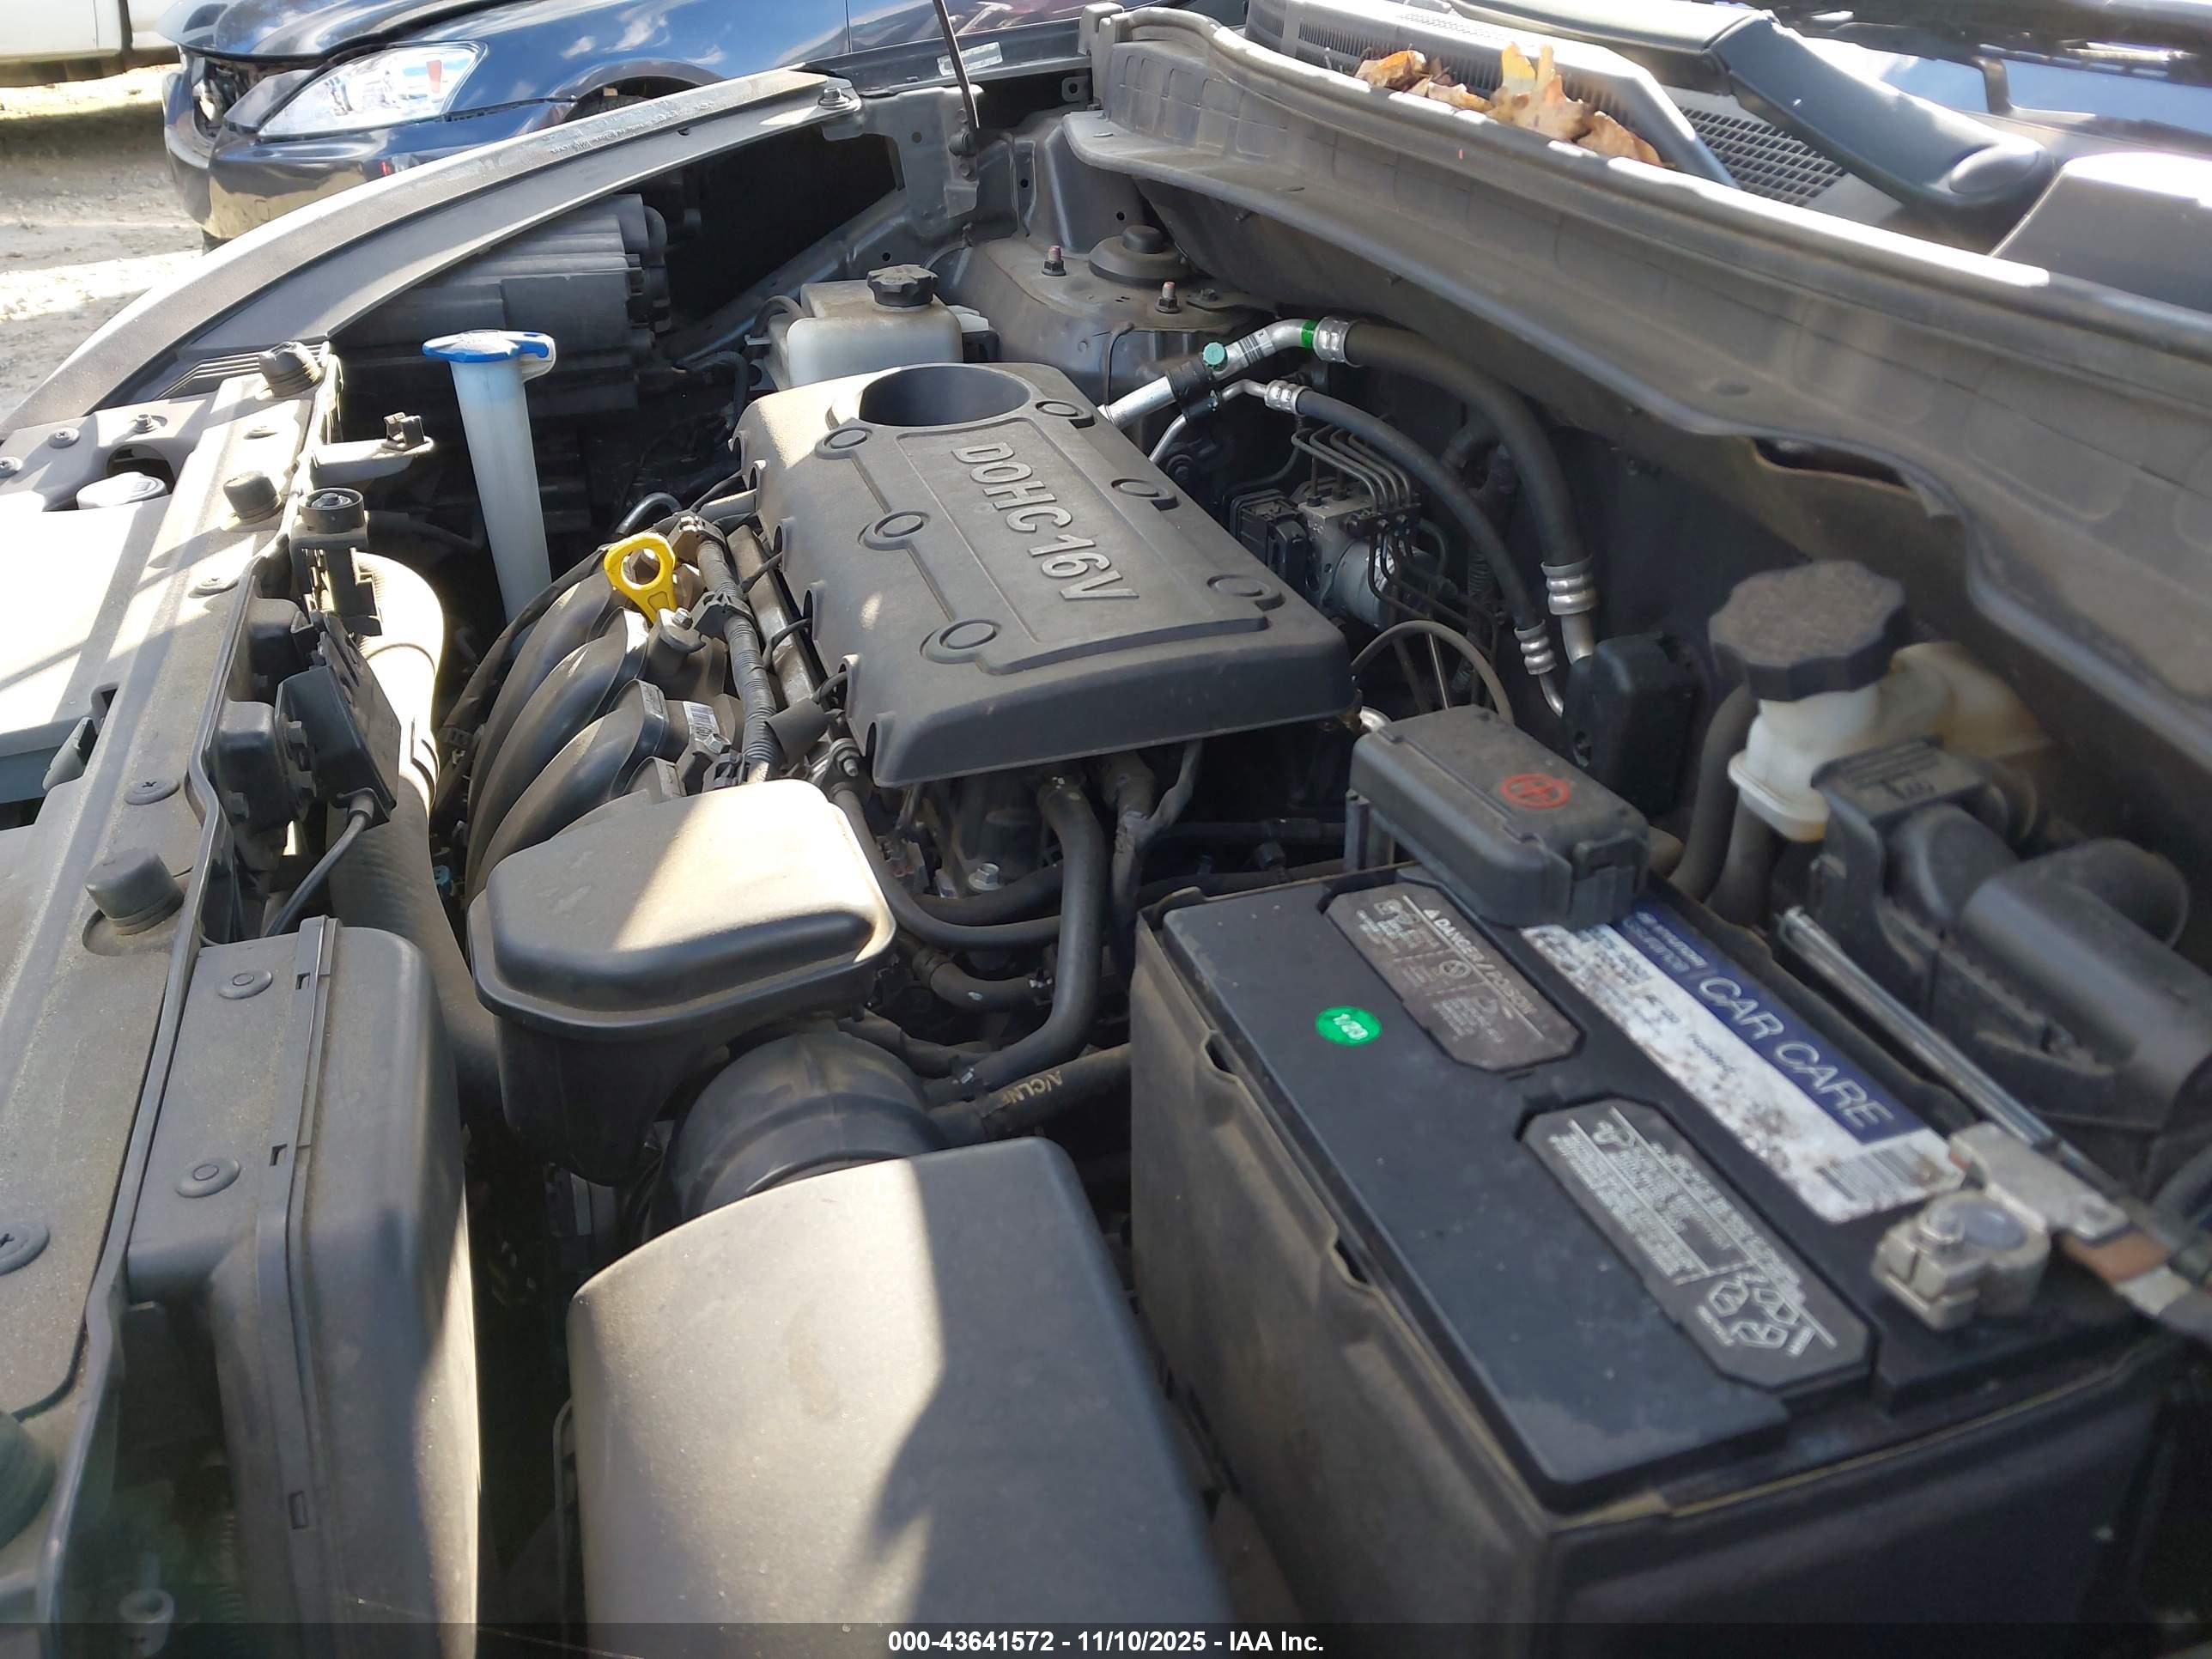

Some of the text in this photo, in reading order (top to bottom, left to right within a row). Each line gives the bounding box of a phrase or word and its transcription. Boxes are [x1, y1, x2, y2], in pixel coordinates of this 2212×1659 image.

[951, 441, 1139, 600] DOHC 16V
[1698, 976, 1785, 1041] CAR
[1774, 1041, 1894, 1129] CARE
